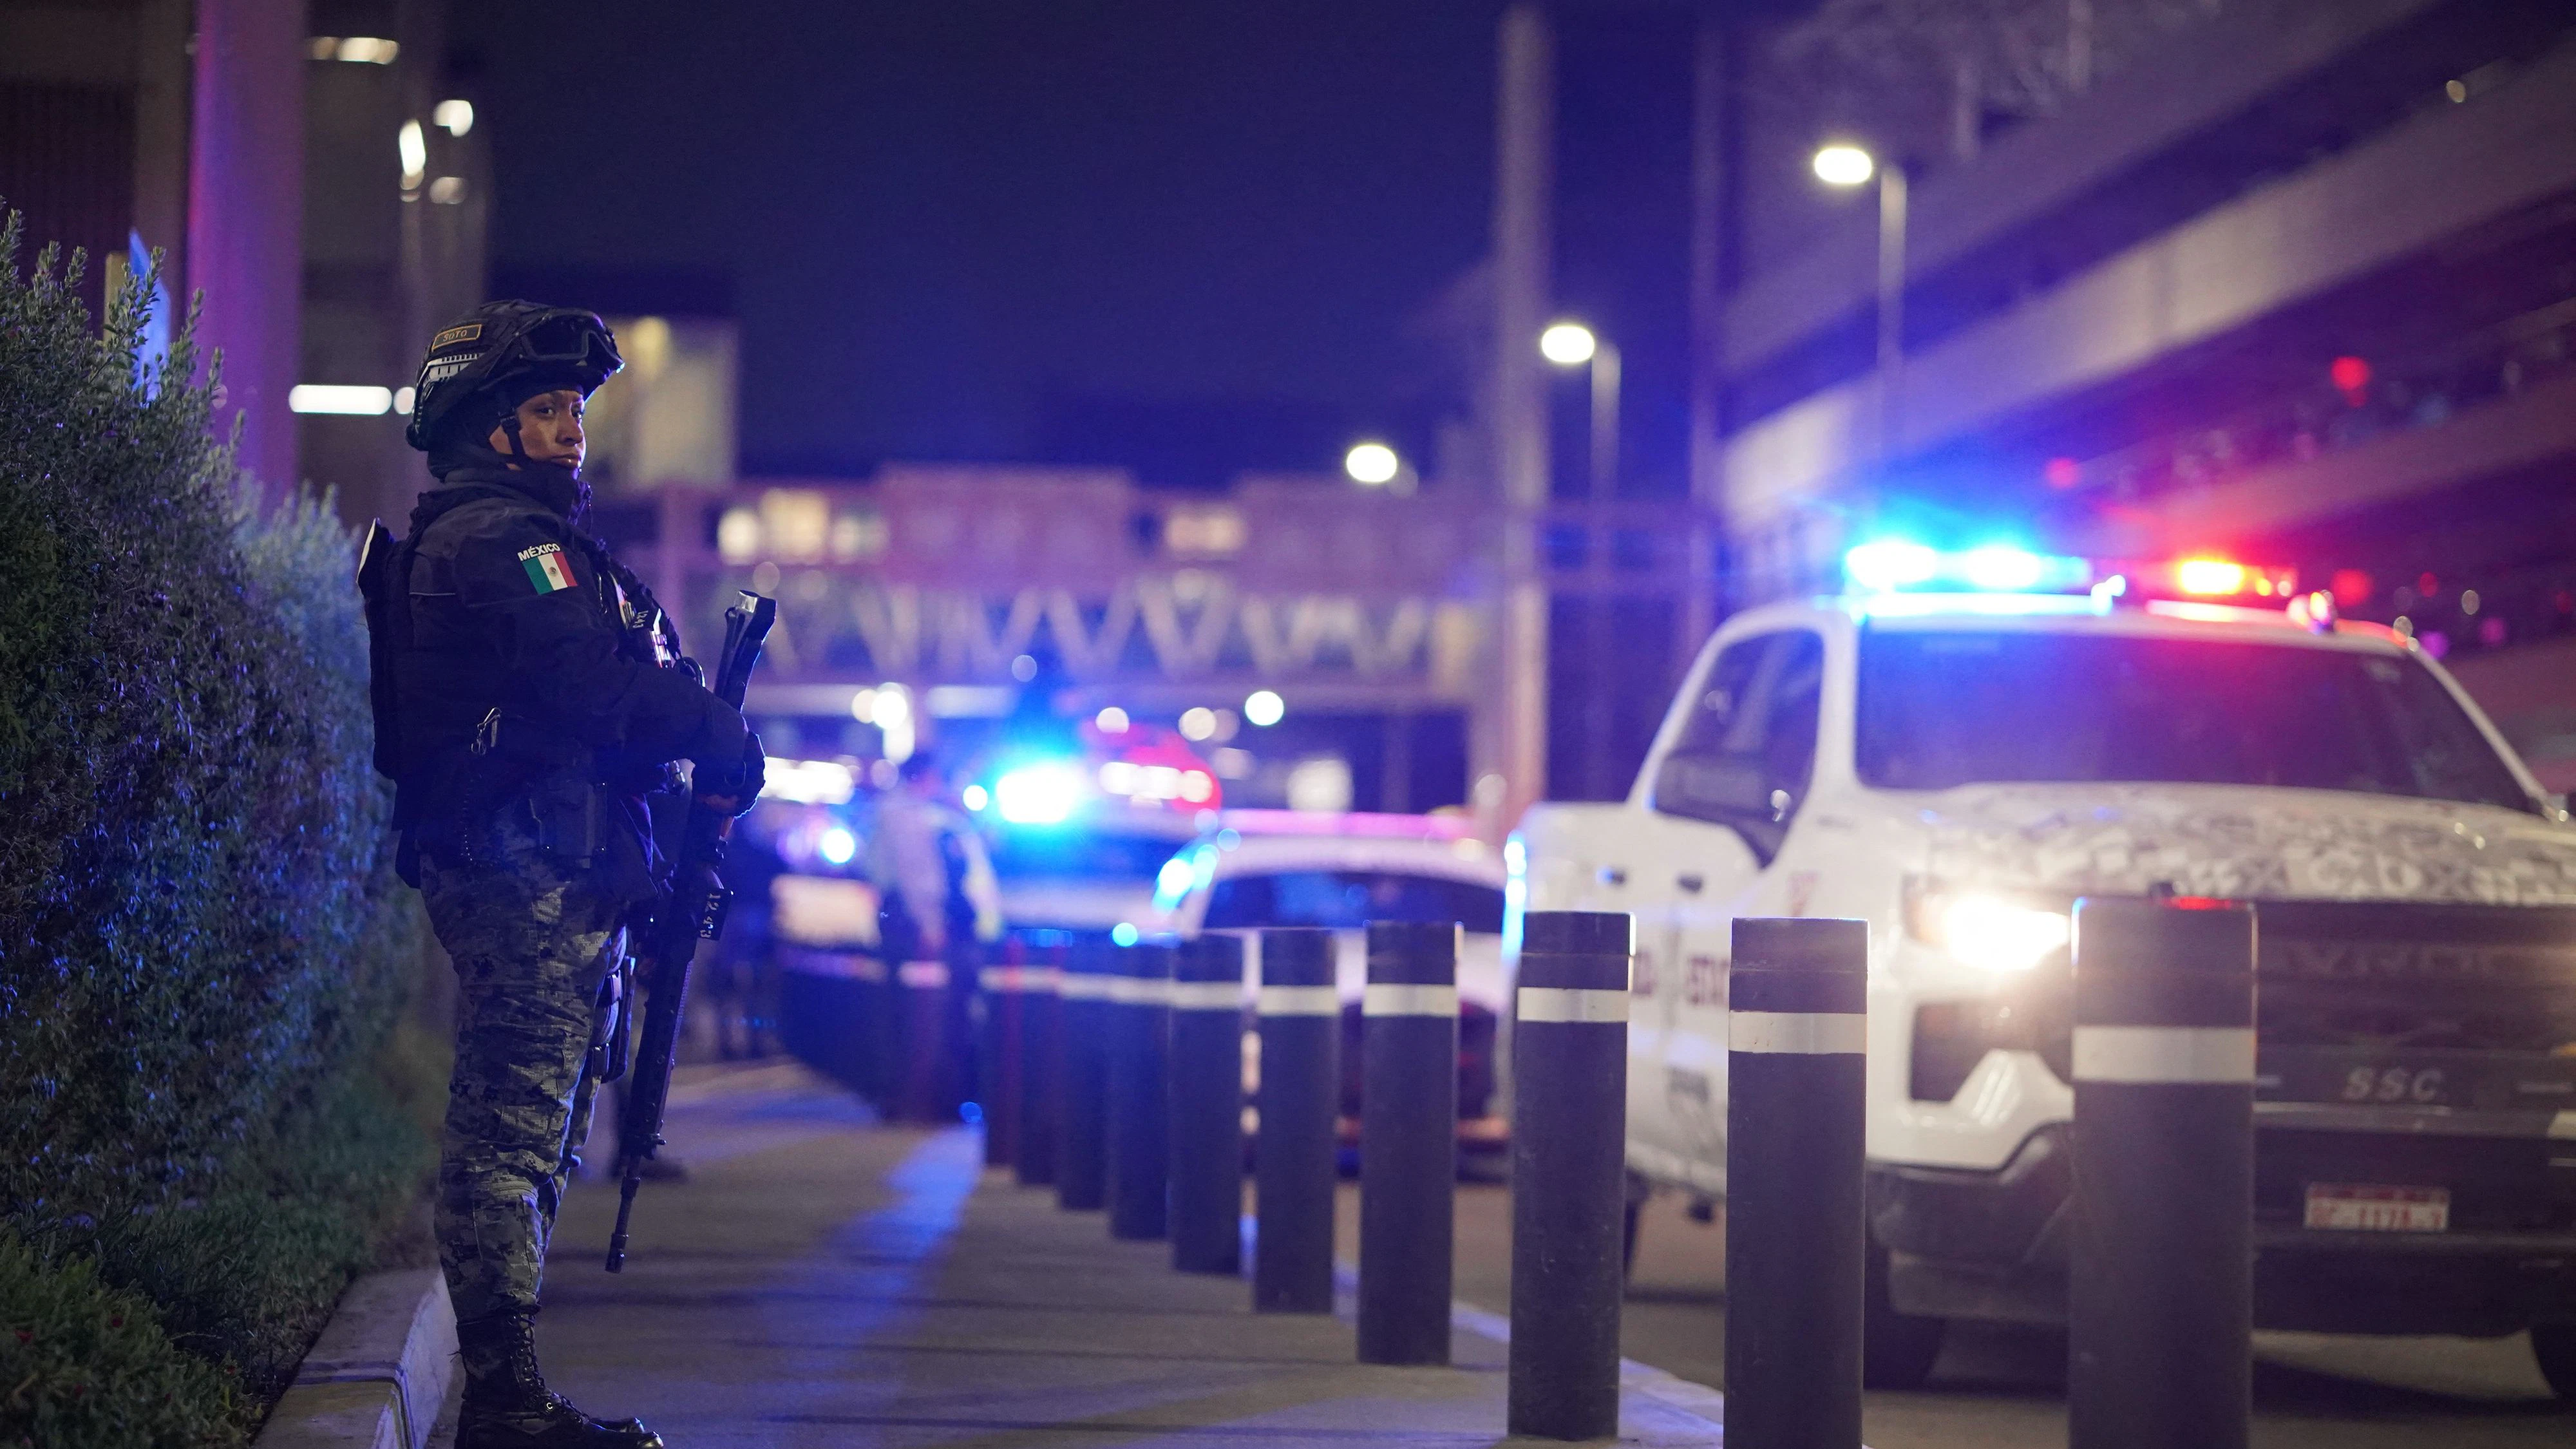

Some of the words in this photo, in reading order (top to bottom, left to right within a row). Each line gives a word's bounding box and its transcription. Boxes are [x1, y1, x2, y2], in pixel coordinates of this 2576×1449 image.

[442, 329, 468, 342] SOTO
[517, 543, 561, 562] MÉXICO
[632, 611, 649, 629] 1243
[699, 893, 721, 938] 1243
[2342, 1066, 2443, 1101] SSC
